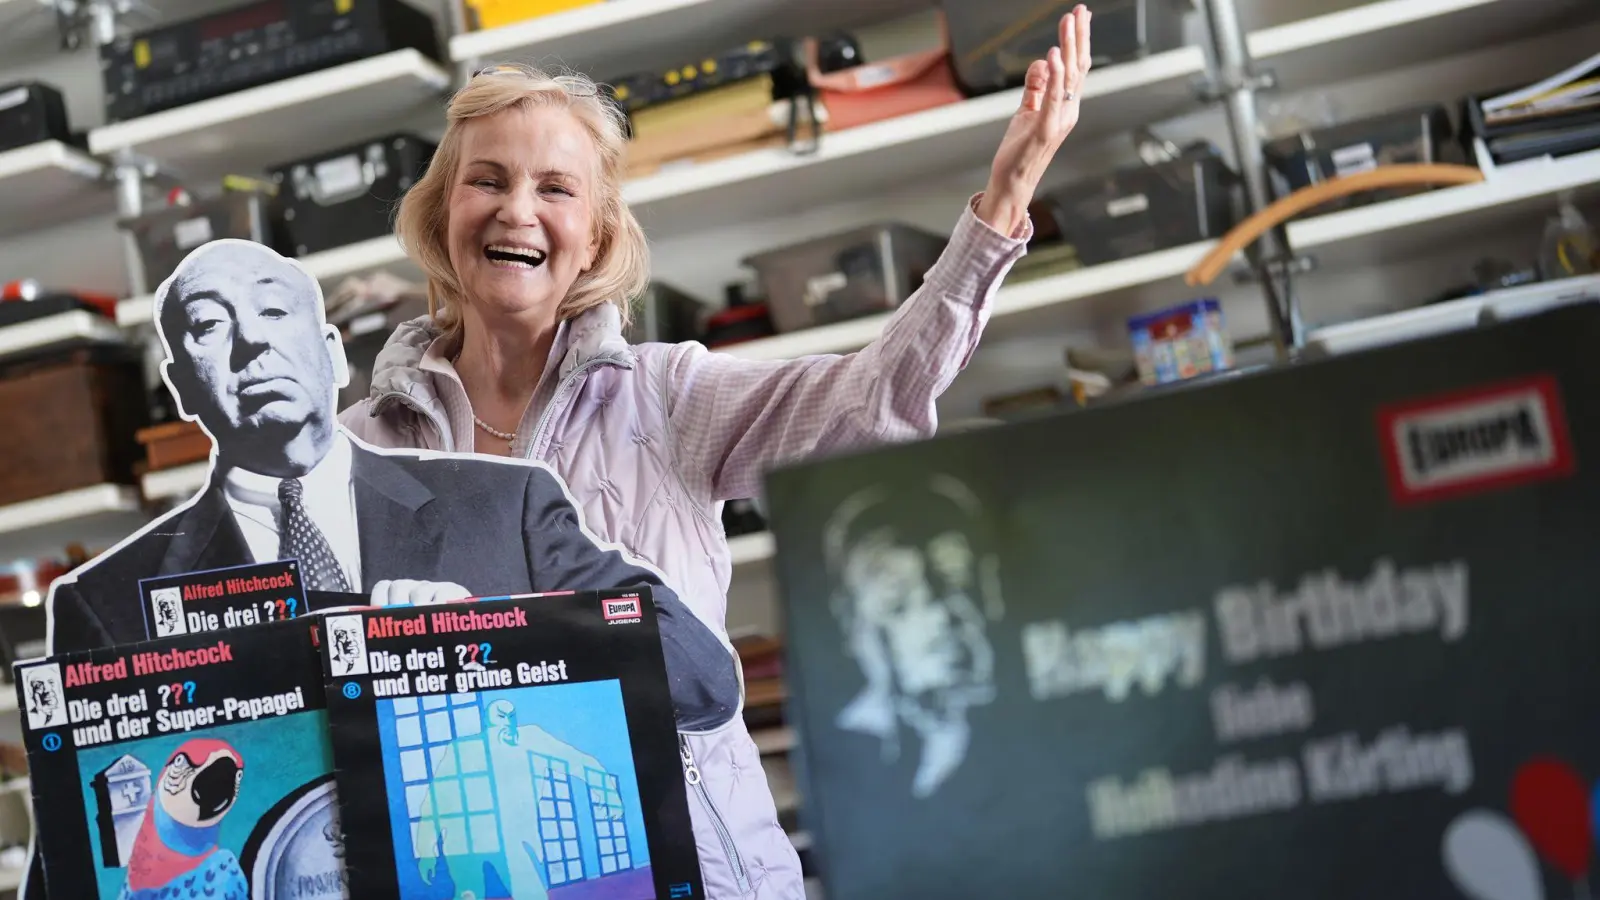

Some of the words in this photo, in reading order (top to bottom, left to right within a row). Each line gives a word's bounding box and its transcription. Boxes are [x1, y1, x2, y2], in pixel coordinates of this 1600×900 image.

[183, 581, 224, 601] Alfred
[226, 572, 294, 595] Hitchcock
[187, 611, 219, 634] Die
[223, 604, 261, 629] drei
[263, 597, 298, 622] ???
[367, 614, 427, 639] Alfred
[431, 607, 528, 634] Hitchcock
[608, 602, 636, 615] EUROPA
[1021, 610, 1206, 702] Happy
[1215, 557, 1470, 662] Birthday
[65, 656, 128, 688] Alfred
[131, 641, 233, 676] Hitchcock
[369, 651, 402, 674] Die
[405, 646, 445, 671] drei
[455, 642, 492, 668] ???
[373, 673, 411, 697] und
[415, 672, 448, 693] der
[454, 668, 513, 694] grüne
[516, 659, 568, 684] Geist
[68, 698, 102, 724] Die
[107, 688, 148, 716] drei
[157, 680, 196, 707] ???
[72, 718, 113, 747] und
[116, 715, 151, 739] der
[155, 686, 305, 732] Super-Papagei
